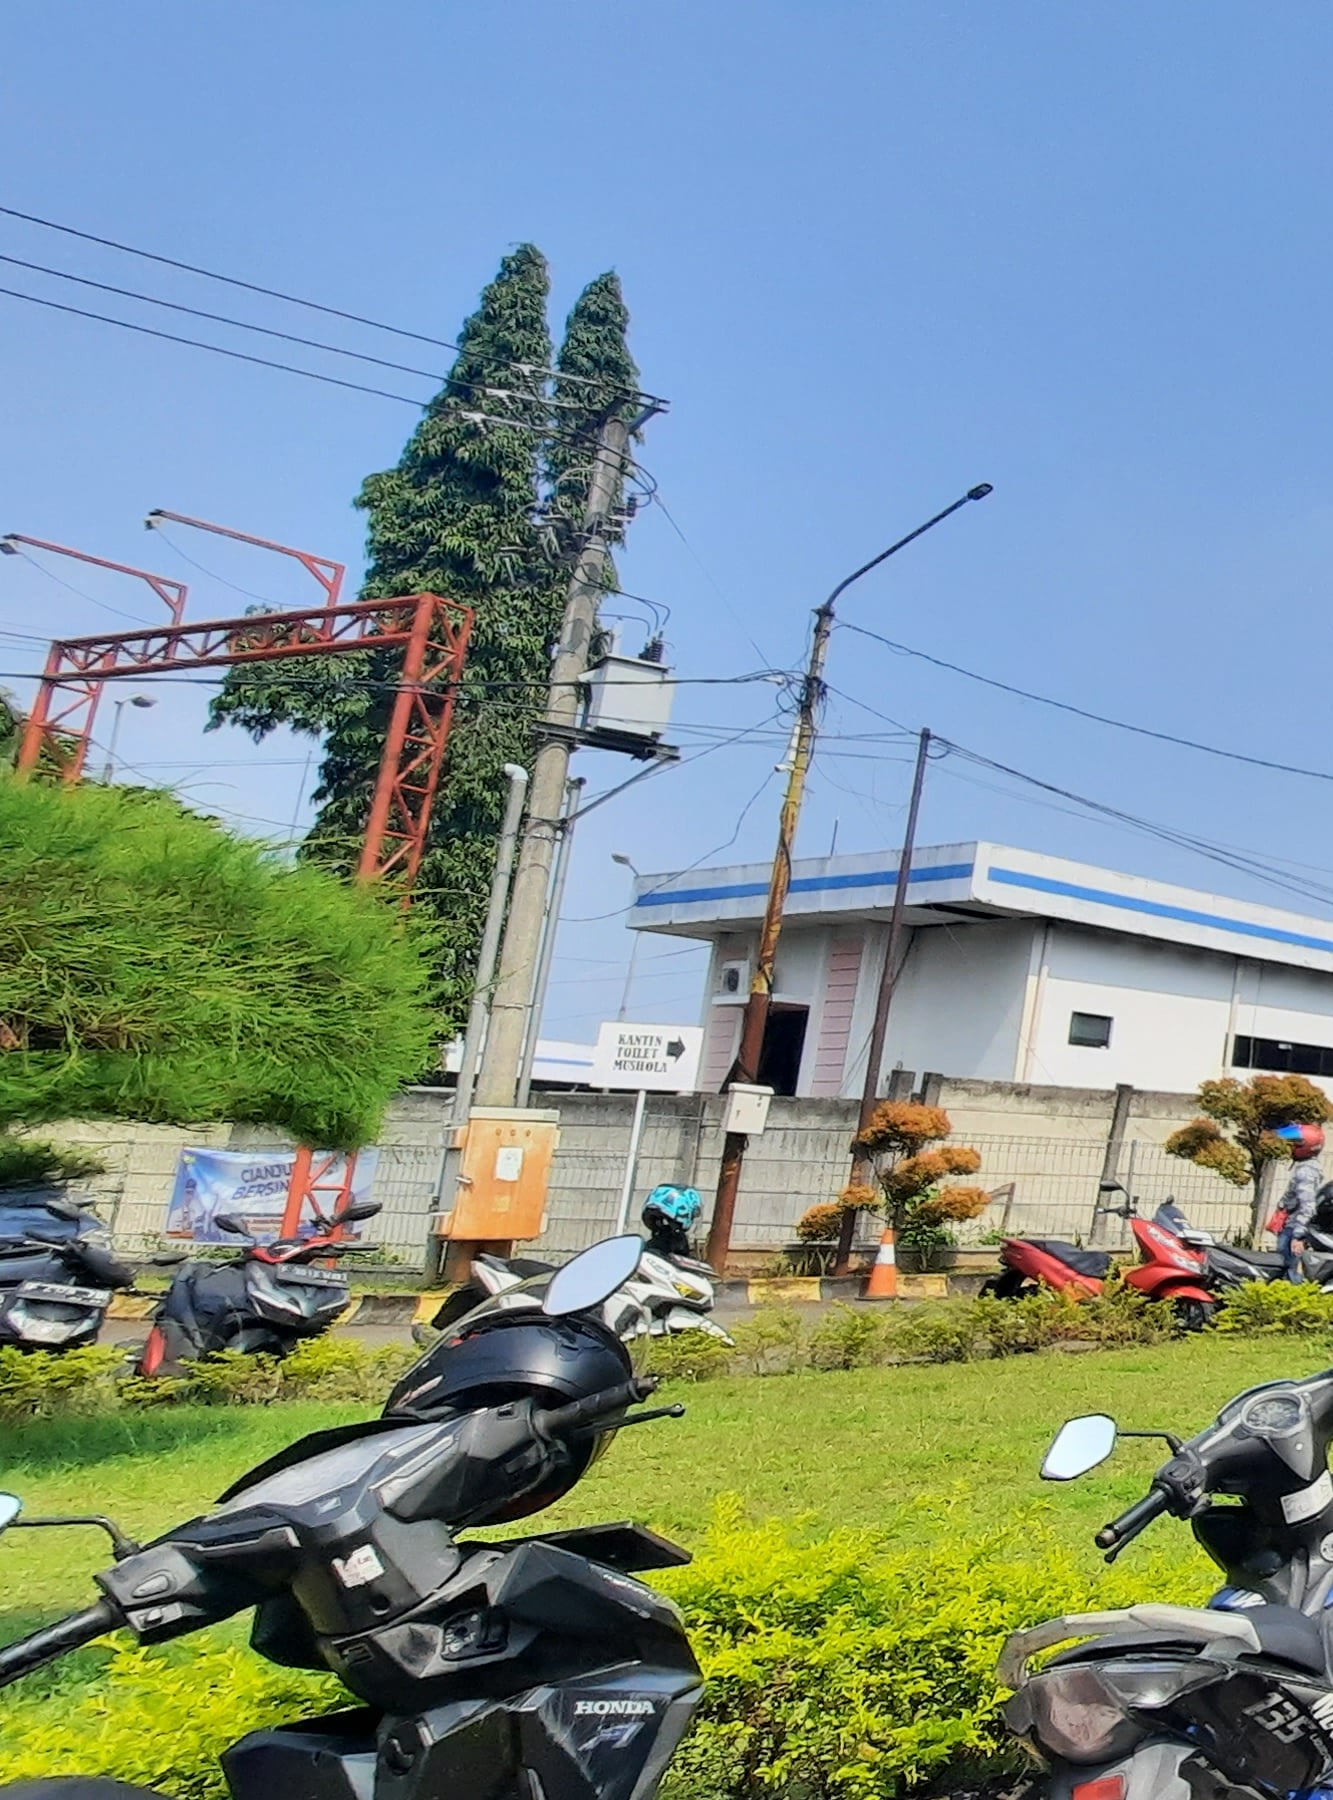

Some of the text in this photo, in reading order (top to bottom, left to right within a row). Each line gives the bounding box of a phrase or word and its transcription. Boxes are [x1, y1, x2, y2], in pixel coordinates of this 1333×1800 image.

[618, 1033, 662, 1047] KANTIN
[617, 1047, 659, 1059] TOILET
[613, 1059, 667, 1073] MUSHOLA
[241, 1163, 293, 1183] CIANJU
[574, 1700, 656, 1716] HONDA
[1241, 1691, 1317, 1745] 135
